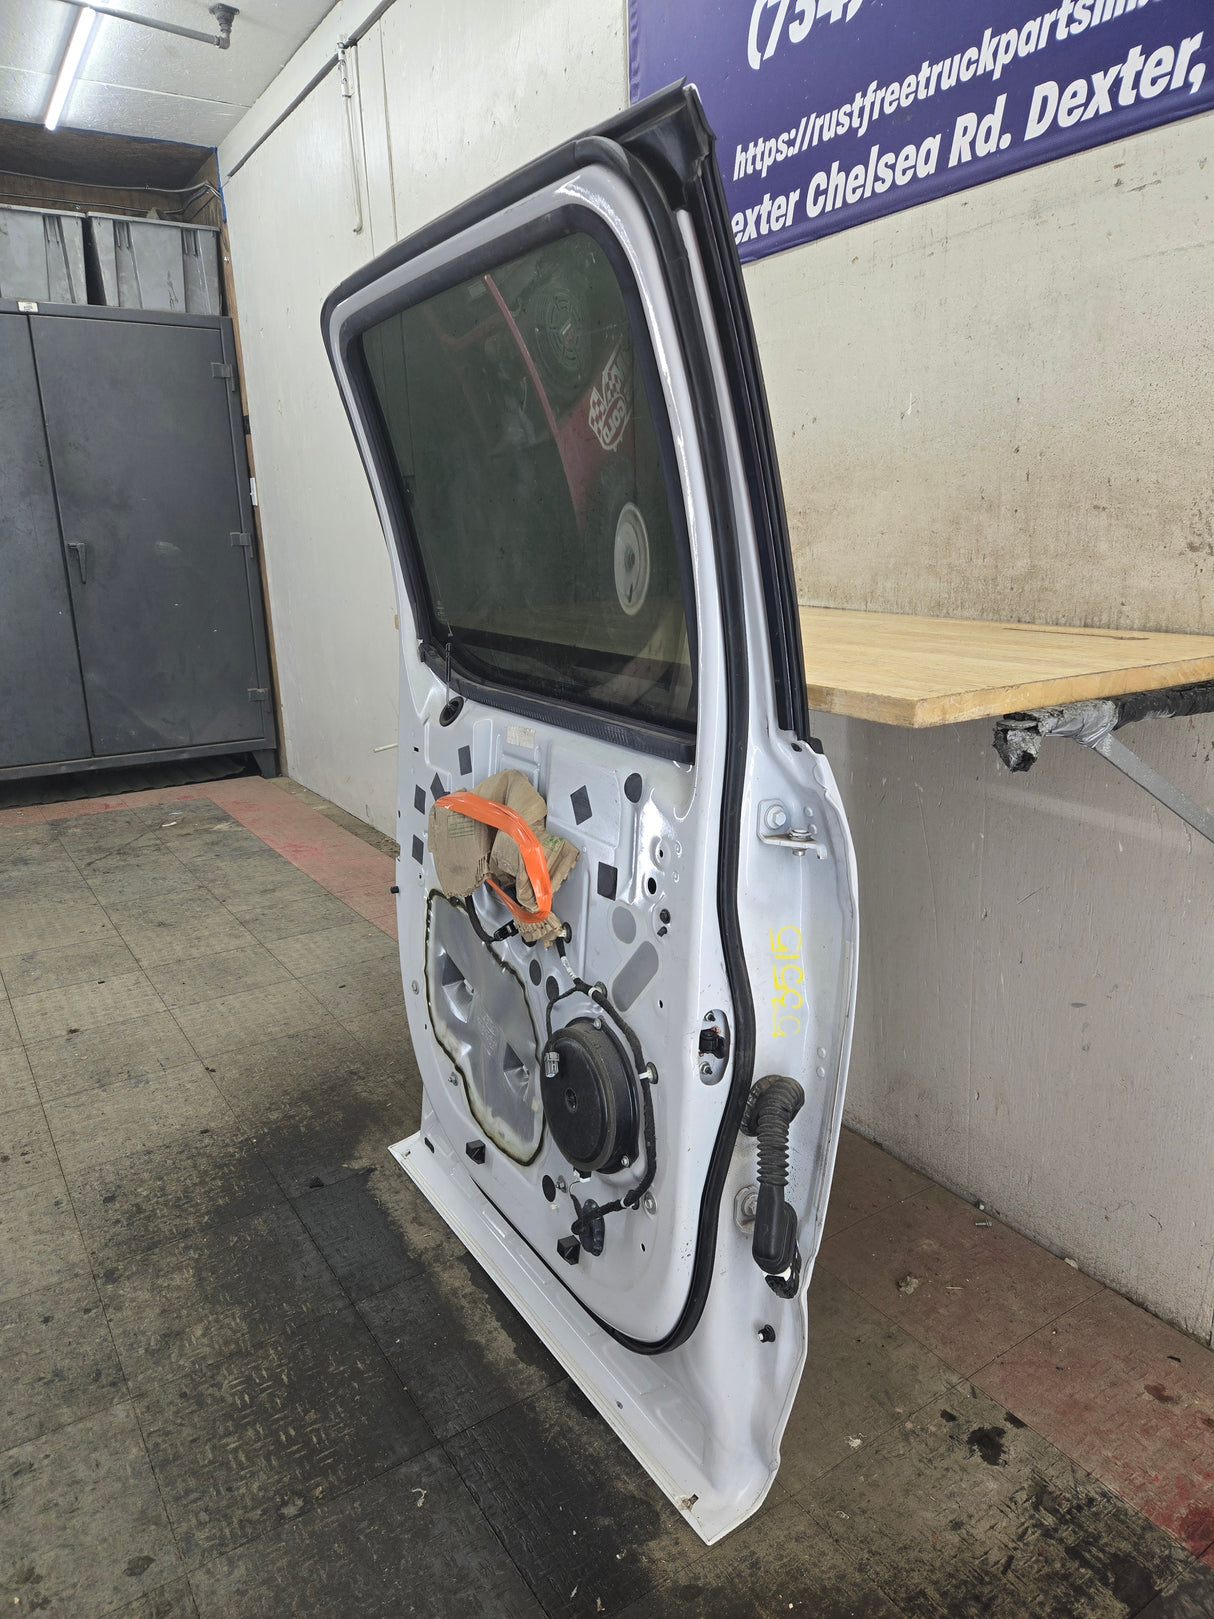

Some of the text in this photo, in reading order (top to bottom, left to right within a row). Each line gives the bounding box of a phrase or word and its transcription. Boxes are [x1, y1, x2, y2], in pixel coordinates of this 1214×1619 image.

[730, 31, 1206, 245] exter Chelsea Rd. Dexter,
[770, 924, 804, 1038] 53515
